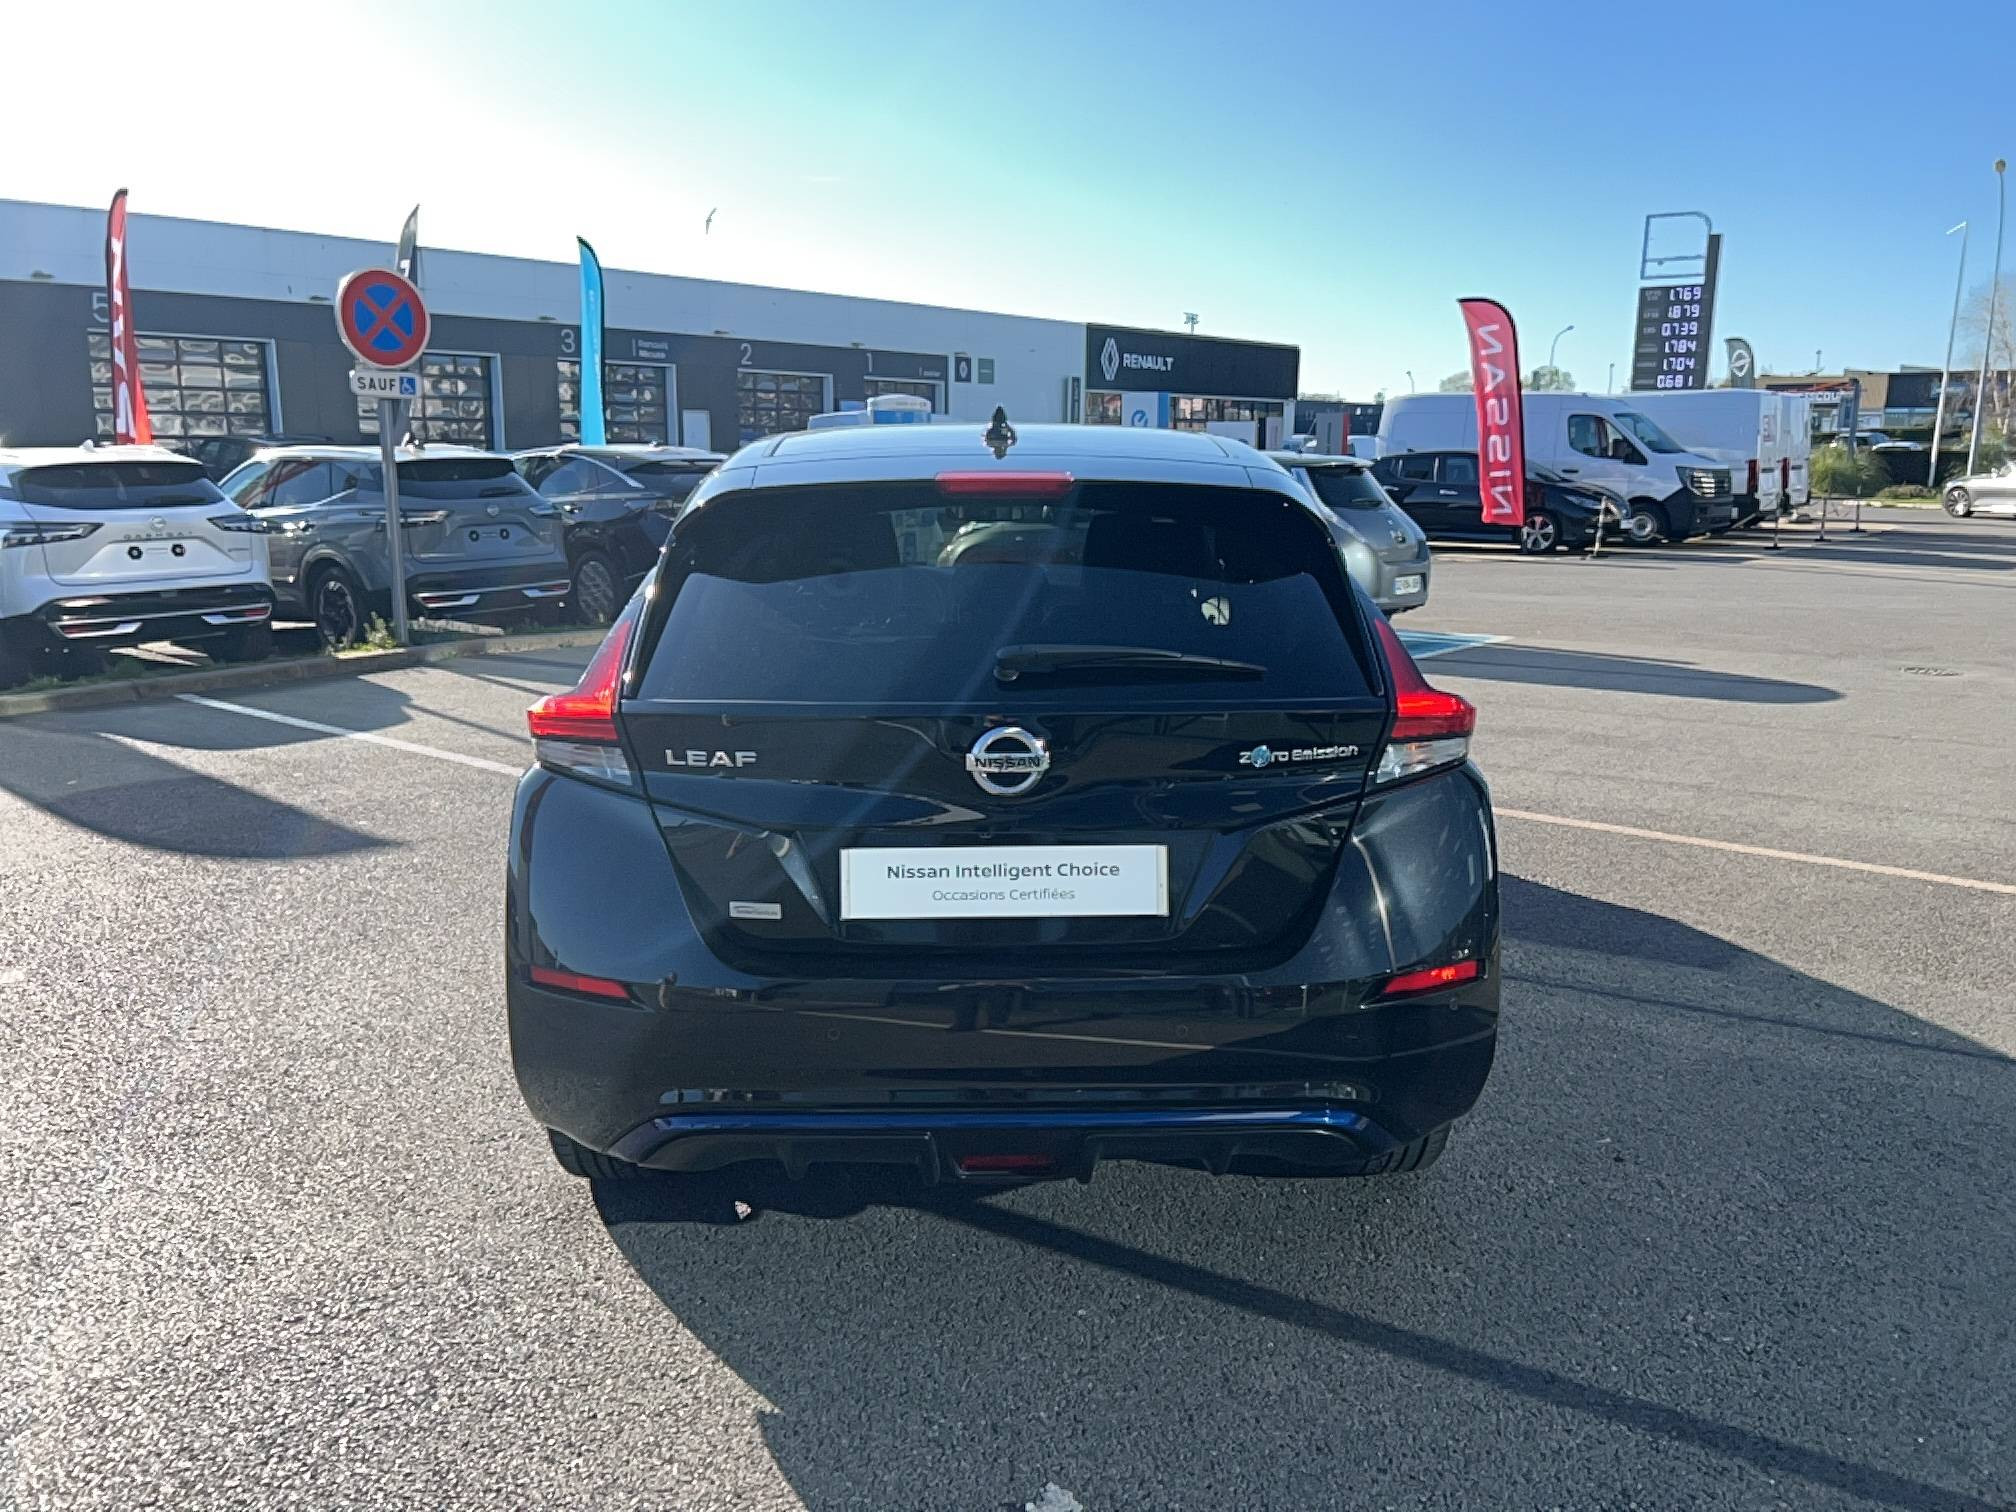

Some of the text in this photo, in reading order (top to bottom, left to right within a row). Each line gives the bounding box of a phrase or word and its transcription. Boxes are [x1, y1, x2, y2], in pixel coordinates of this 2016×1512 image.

[561, 329, 576, 353] 3
[740, 342, 753, 365] 2
[1122, 353, 1174, 371] RENAULT
[356, 376, 397, 392] SAUF
[664, 748, 758, 768] LEAF
[975, 757, 1041, 769] NISSAN
[886, 862, 1121, 880] Nissan Intelligent Choice
[931, 888, 1076, 901] Occasions Certifiées
